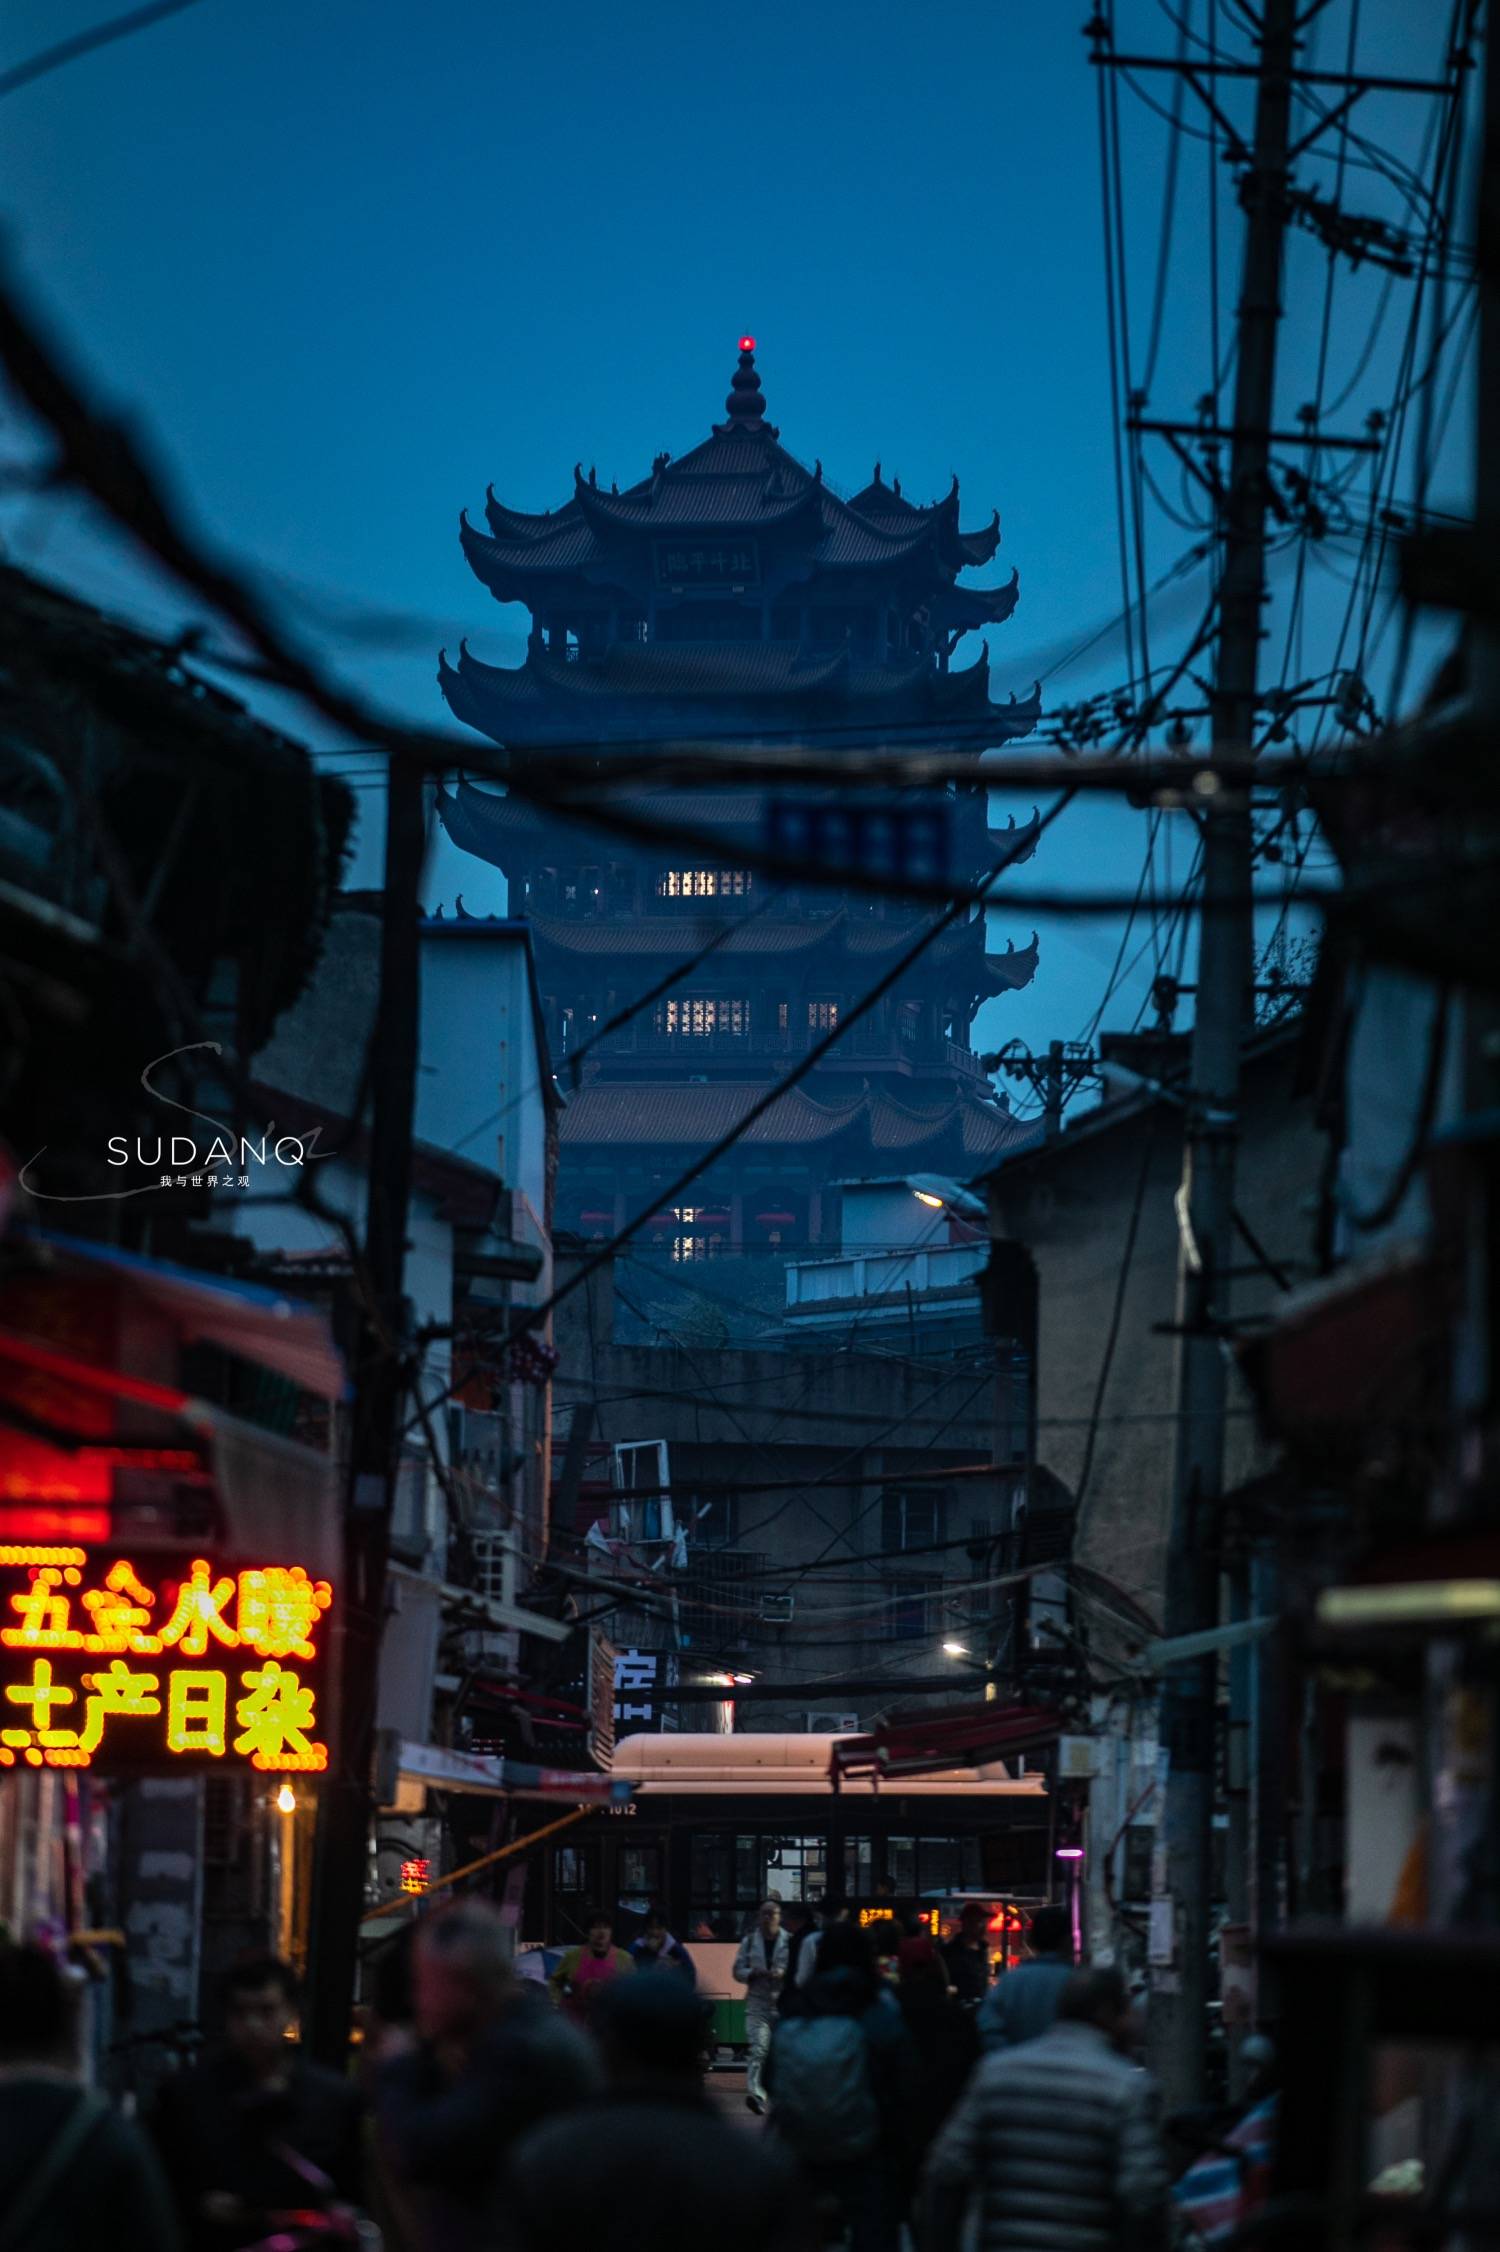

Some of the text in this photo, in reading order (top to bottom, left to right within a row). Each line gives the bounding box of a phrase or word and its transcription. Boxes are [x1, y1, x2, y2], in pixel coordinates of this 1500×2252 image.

[1, 1559, 321, 1659] 五金水暖
[2, 1658, 317, 1757] 土产日杂
